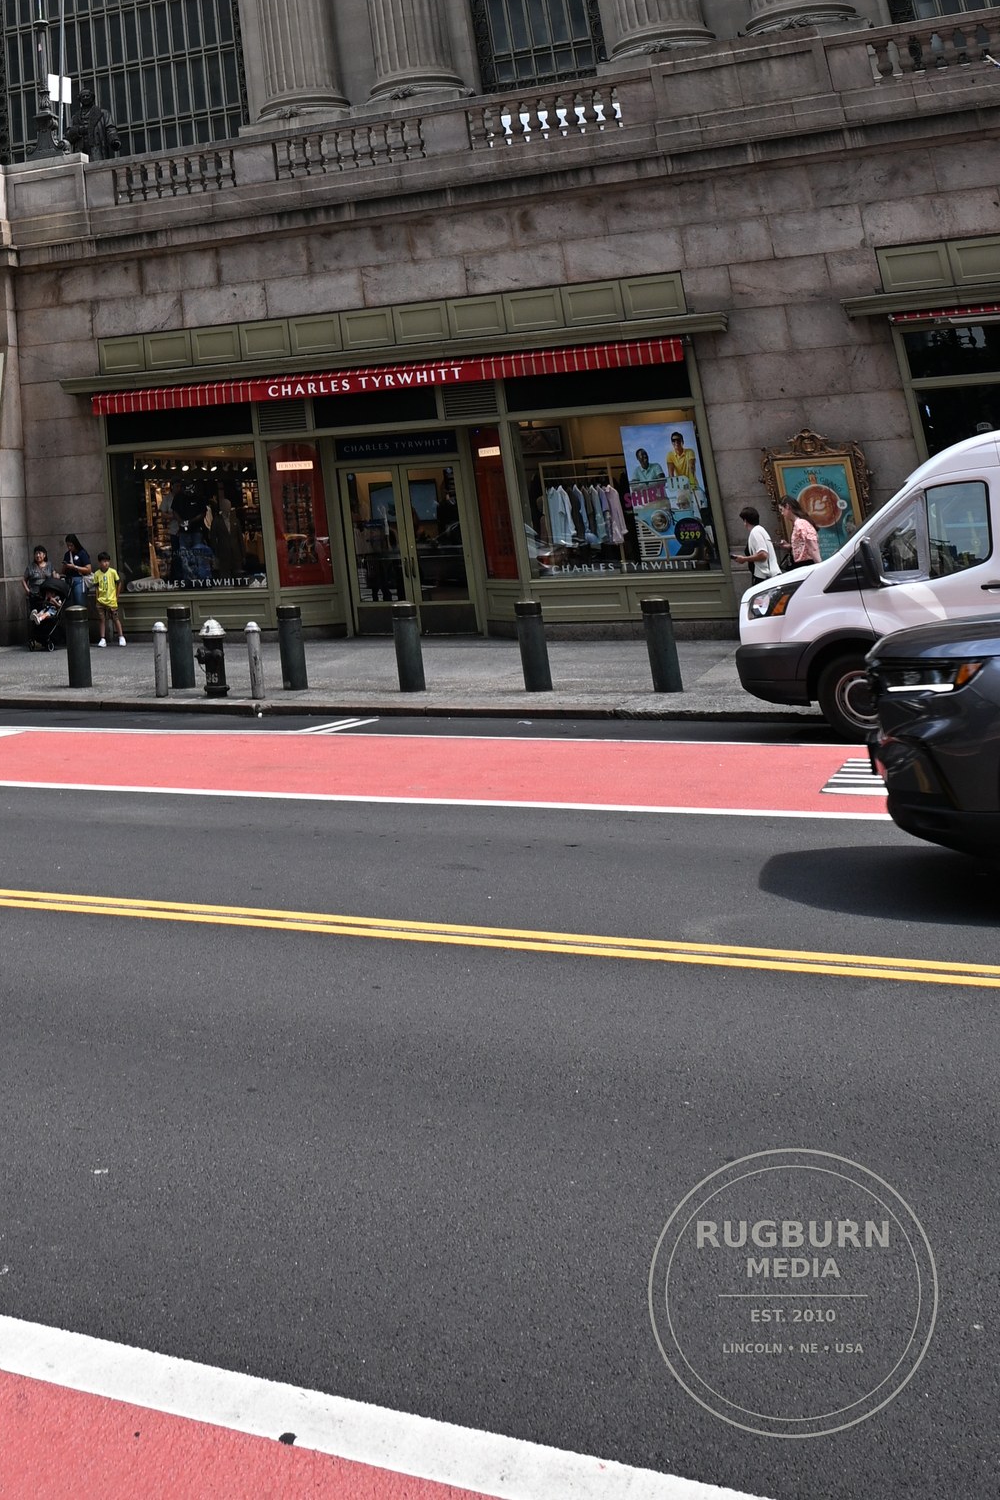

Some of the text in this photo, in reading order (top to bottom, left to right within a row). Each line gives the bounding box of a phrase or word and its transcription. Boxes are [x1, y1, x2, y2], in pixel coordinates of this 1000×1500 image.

[267, 367, 463, 398] CHARLES TYRWHITT
[343, 438, 449, 453] CHARLES TYRWHITT
[623, 482, 666, 508] SHIRT
[679, 531, 701, 540] $299
[551, 560, 698, 574] CHARLES TYRWHITT
[191, 578, 250, 587] TYRWHITT
